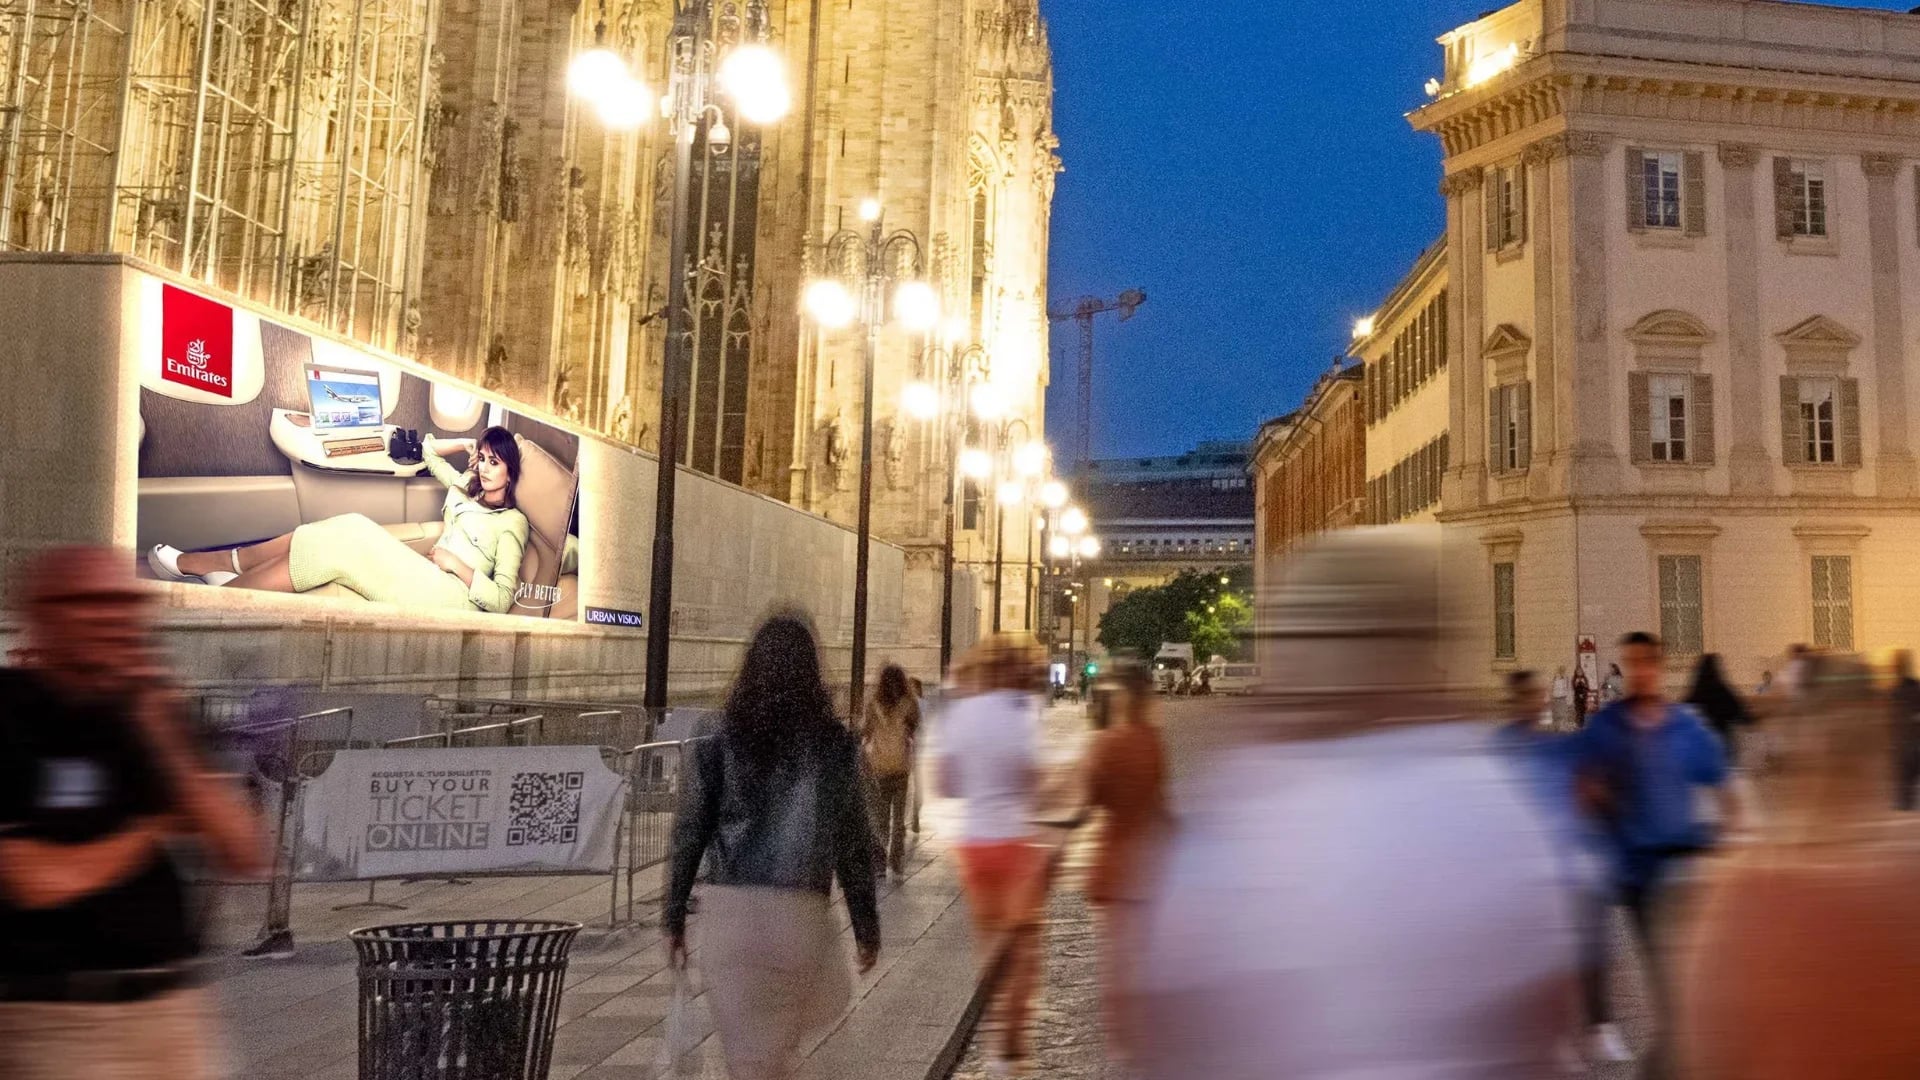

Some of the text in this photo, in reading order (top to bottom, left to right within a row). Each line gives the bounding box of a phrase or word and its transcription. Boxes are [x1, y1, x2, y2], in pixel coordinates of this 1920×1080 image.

[167, 358, 227, 387] Emirates
[519, 582, 562, 602] FLY BETTER
[587, 610, 642, 626] URBAN VISION
[370, 778, 489, 793] BUY YOUR
[370, 795, 489, 820] TICKET
[369, 825, 488, 849] ONLINE
